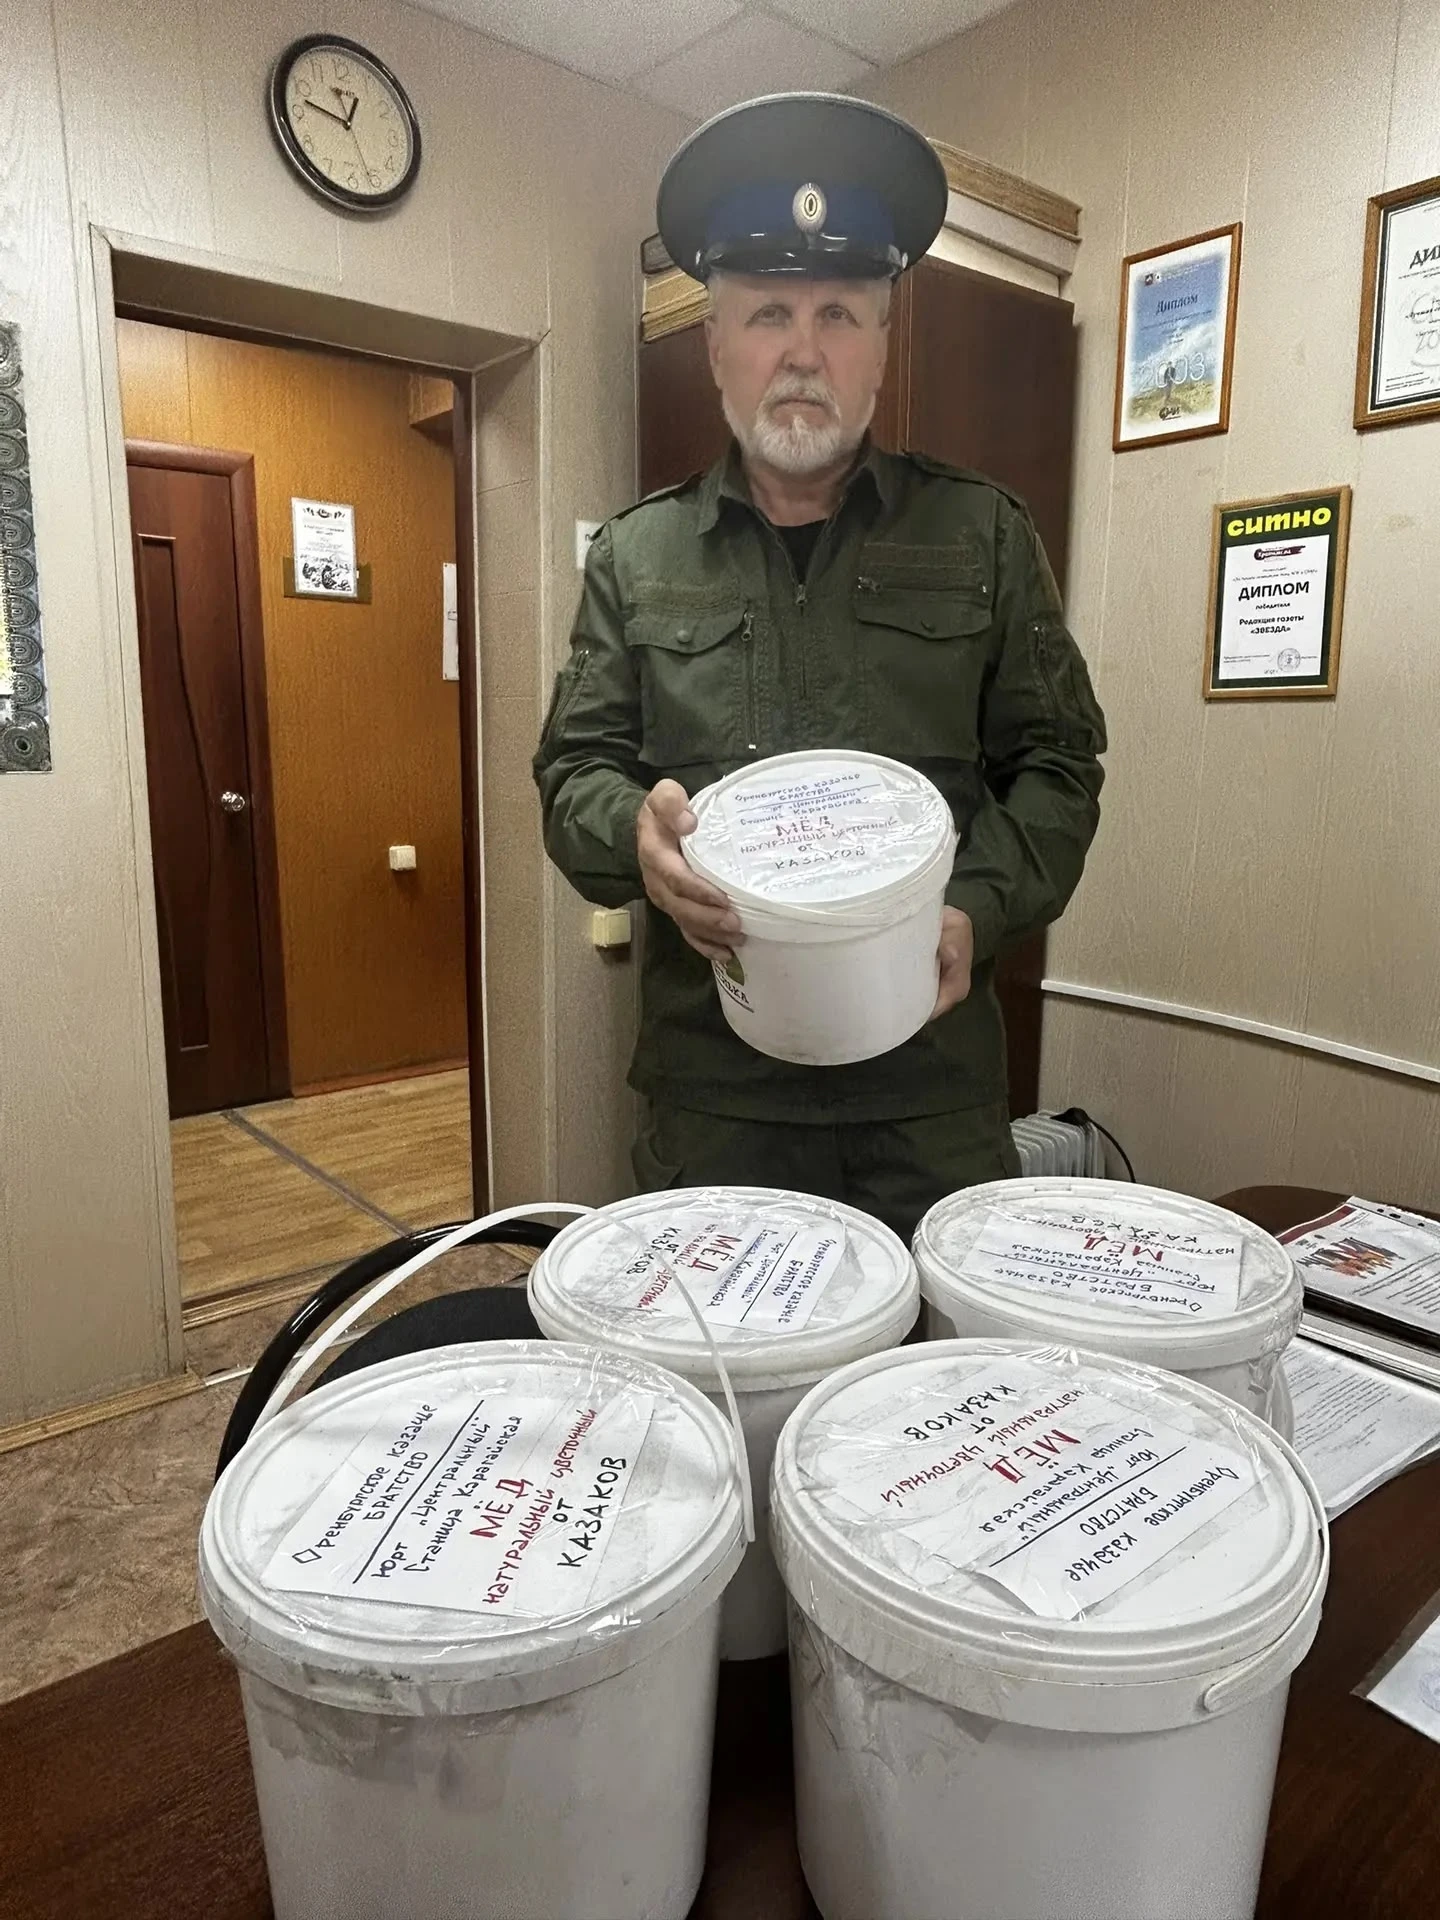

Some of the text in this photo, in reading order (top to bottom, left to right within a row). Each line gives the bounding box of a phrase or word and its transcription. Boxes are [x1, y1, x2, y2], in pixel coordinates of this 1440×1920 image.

[1155, 294, 1199, 315] Диплом
[1238, 581, 1310, 601] ДИПЛОМ
[1239, 617, 1275, 626] Редакция
[1250, 625, 1291, 635] «ЗВЕЗДА»
[776, 815, 835, 837] МЁД
[687, 1234, 742, 1272] МЁД
[1083, 1233, 1164, 1262] МЁД
[903, 1384, 1017, 1441] КАЗАКОВ
[880, 1388, 1085, 1508] натуральный цветочный
[982, 1429, 1082, 1484] МЁД
[1126, 1448, 1161, 1468] Юрт
[362, 1451, 429, 1521] БРАТСТВО
[403, 1415, 523, 1572] Станица Карагайская
[482, 1408, 598, 1604] натуральный цветочный
[979, 1427, 1155, 1533] Станица Карагайская
[292, 1466, 392, 1564] Оренбургское
[469, 1478, 535, 1539] МЁД
[556, 1456, 627, 1568] КАЗАКОВ
[1064, 1466, 1240, 1582] Оренбургское казачье
[1079, 1486, 1159, 1536] БРАТСТВО
